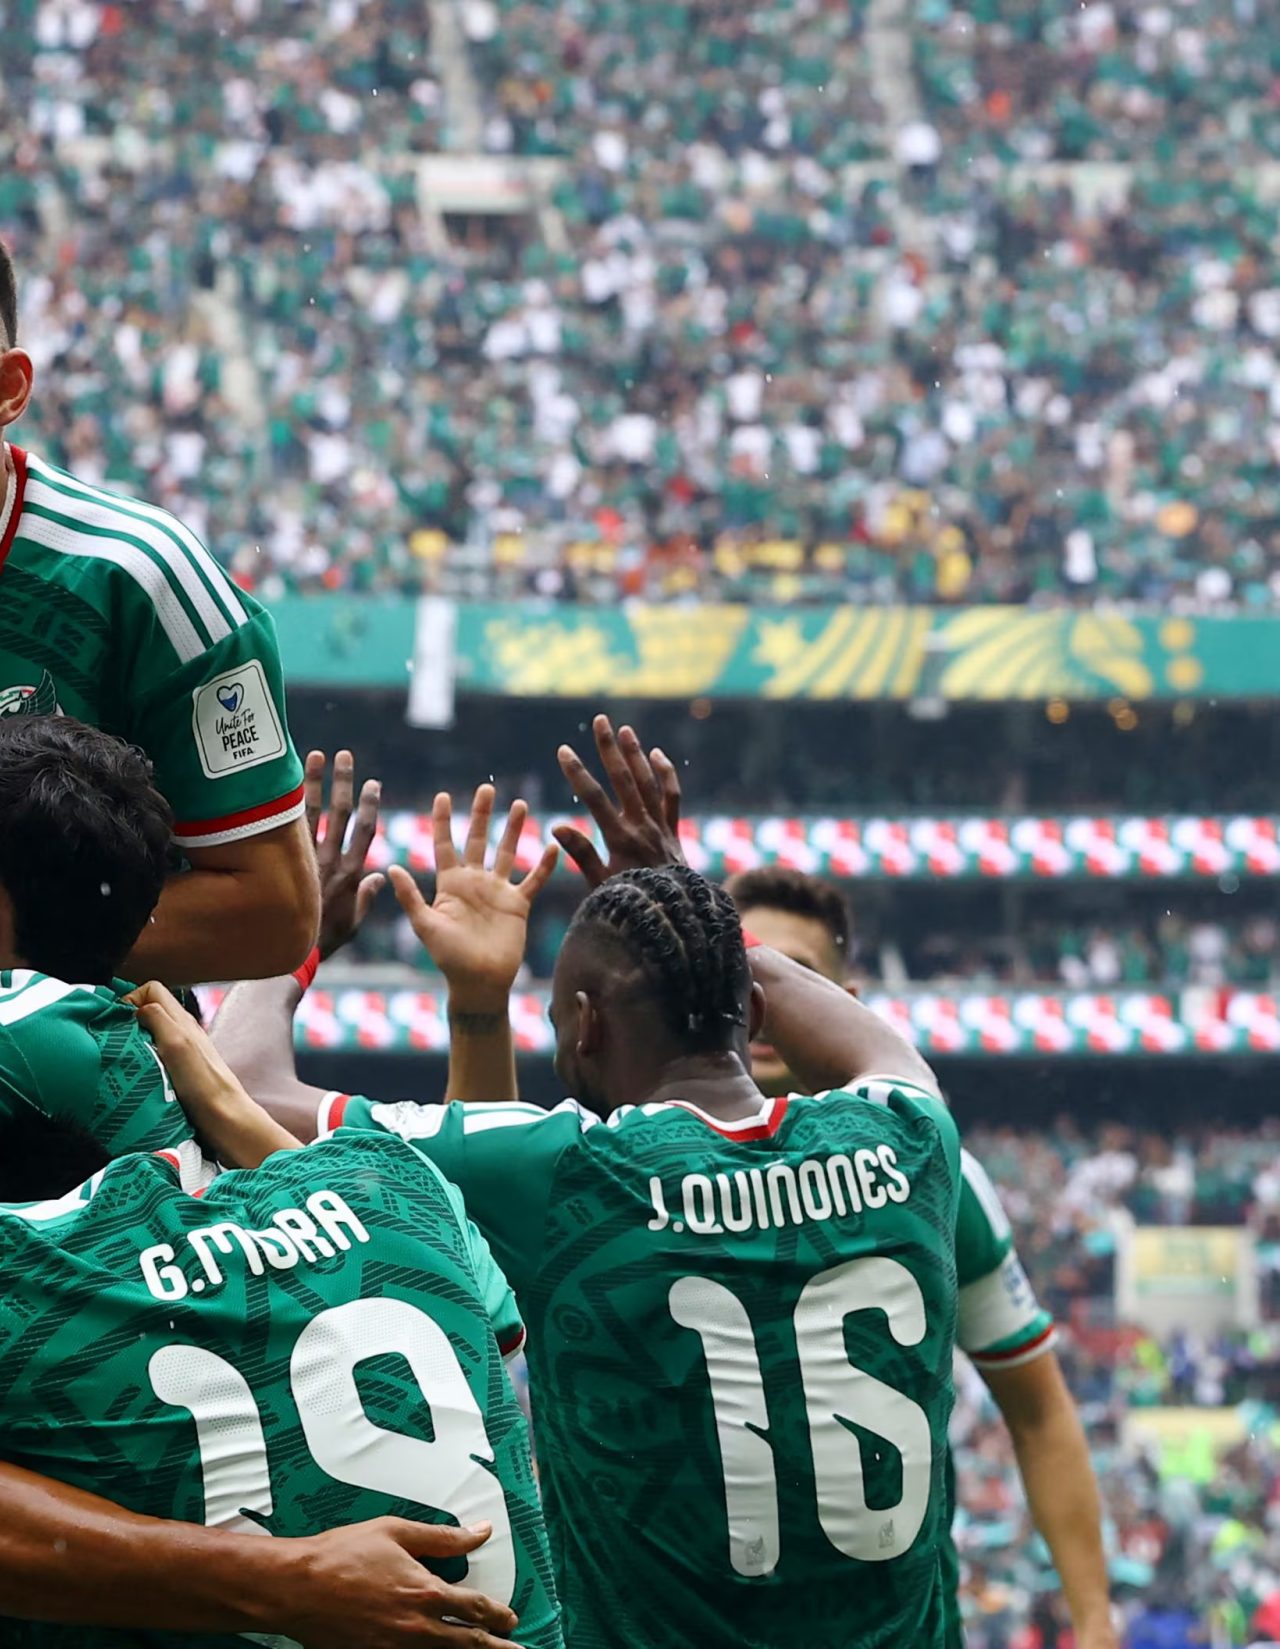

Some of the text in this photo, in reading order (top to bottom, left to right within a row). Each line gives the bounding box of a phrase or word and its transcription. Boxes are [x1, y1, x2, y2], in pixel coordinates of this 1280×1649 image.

[215, 708, 255, 735] Unite For
[222, 725, 259, 752] PEACE
[233, 747, 254, 760] FIFA
[139, 1189, 371, 1301] G.MORA
[668, 1256, 933, 1577] 16
